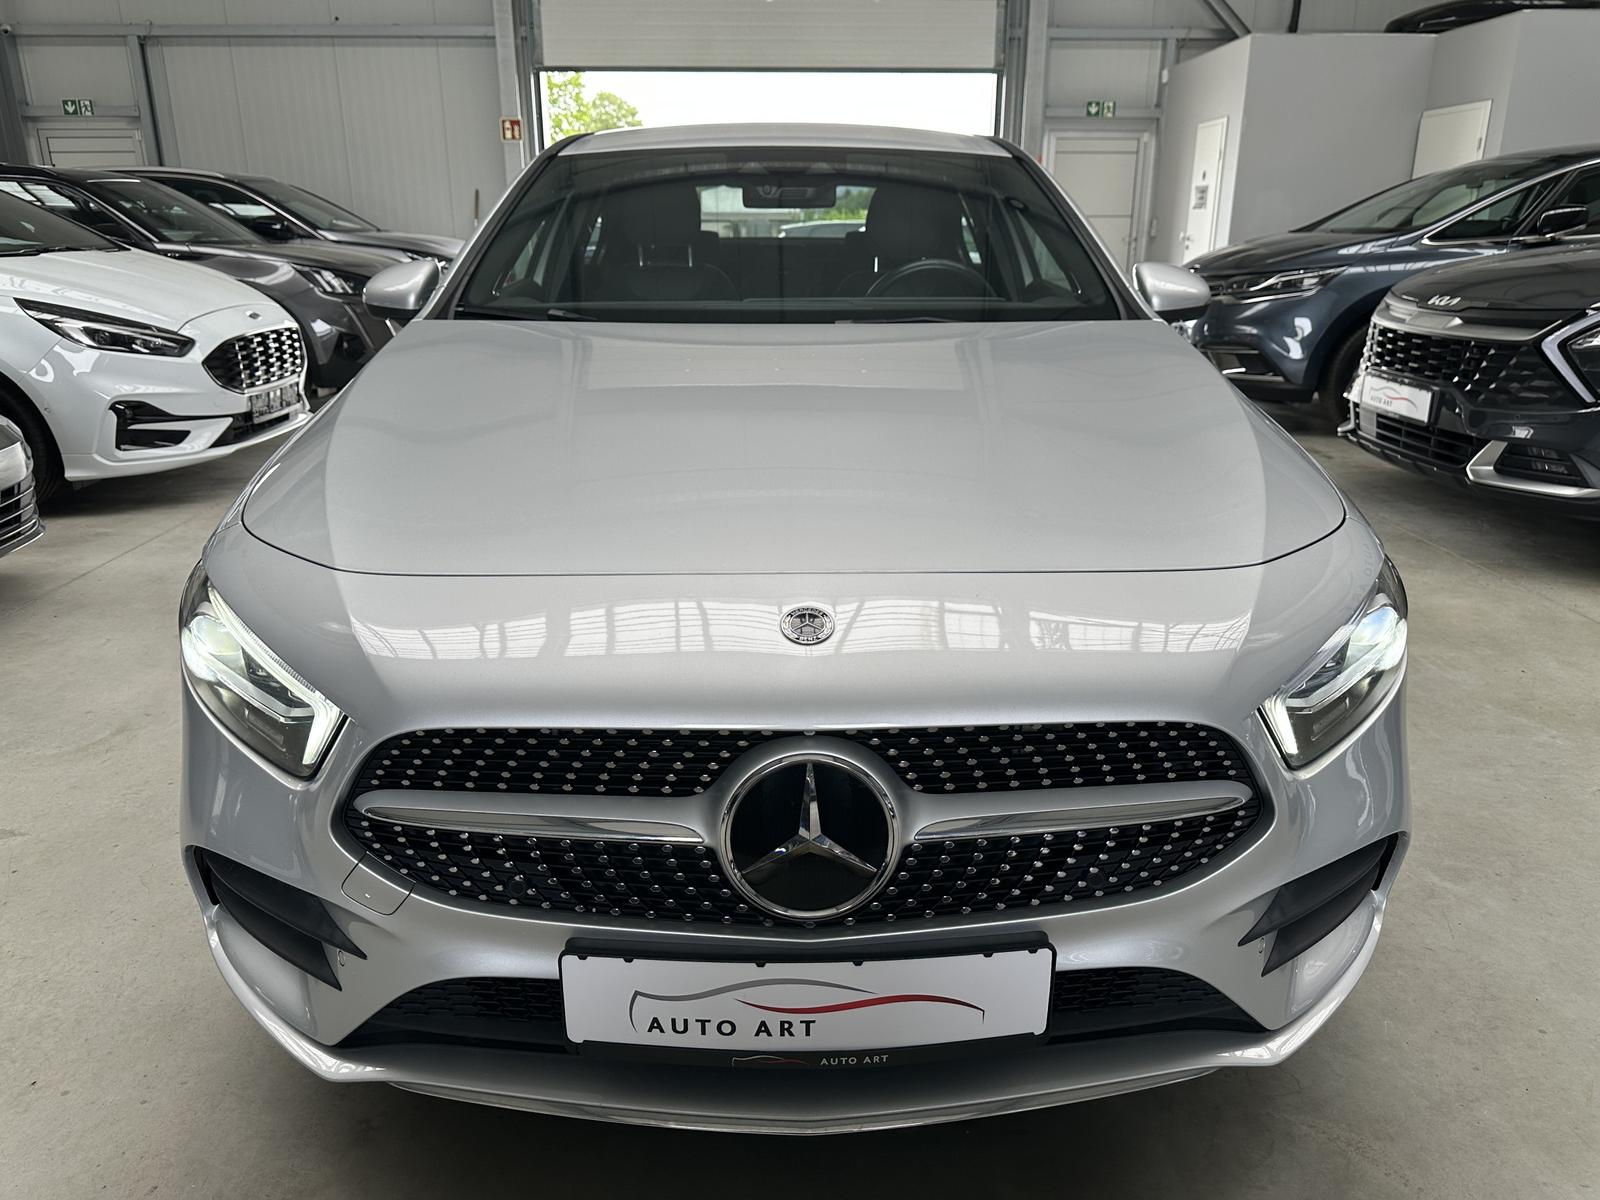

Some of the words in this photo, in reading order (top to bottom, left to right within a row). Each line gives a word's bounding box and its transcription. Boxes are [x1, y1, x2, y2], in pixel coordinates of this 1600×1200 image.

[646, 1016, 737, 1037] AUTO
[753, 1019, 817, 1038] ART
[820, 1057, 857, 1066] AUTO
[863, 1054, 889, 1064] ART
